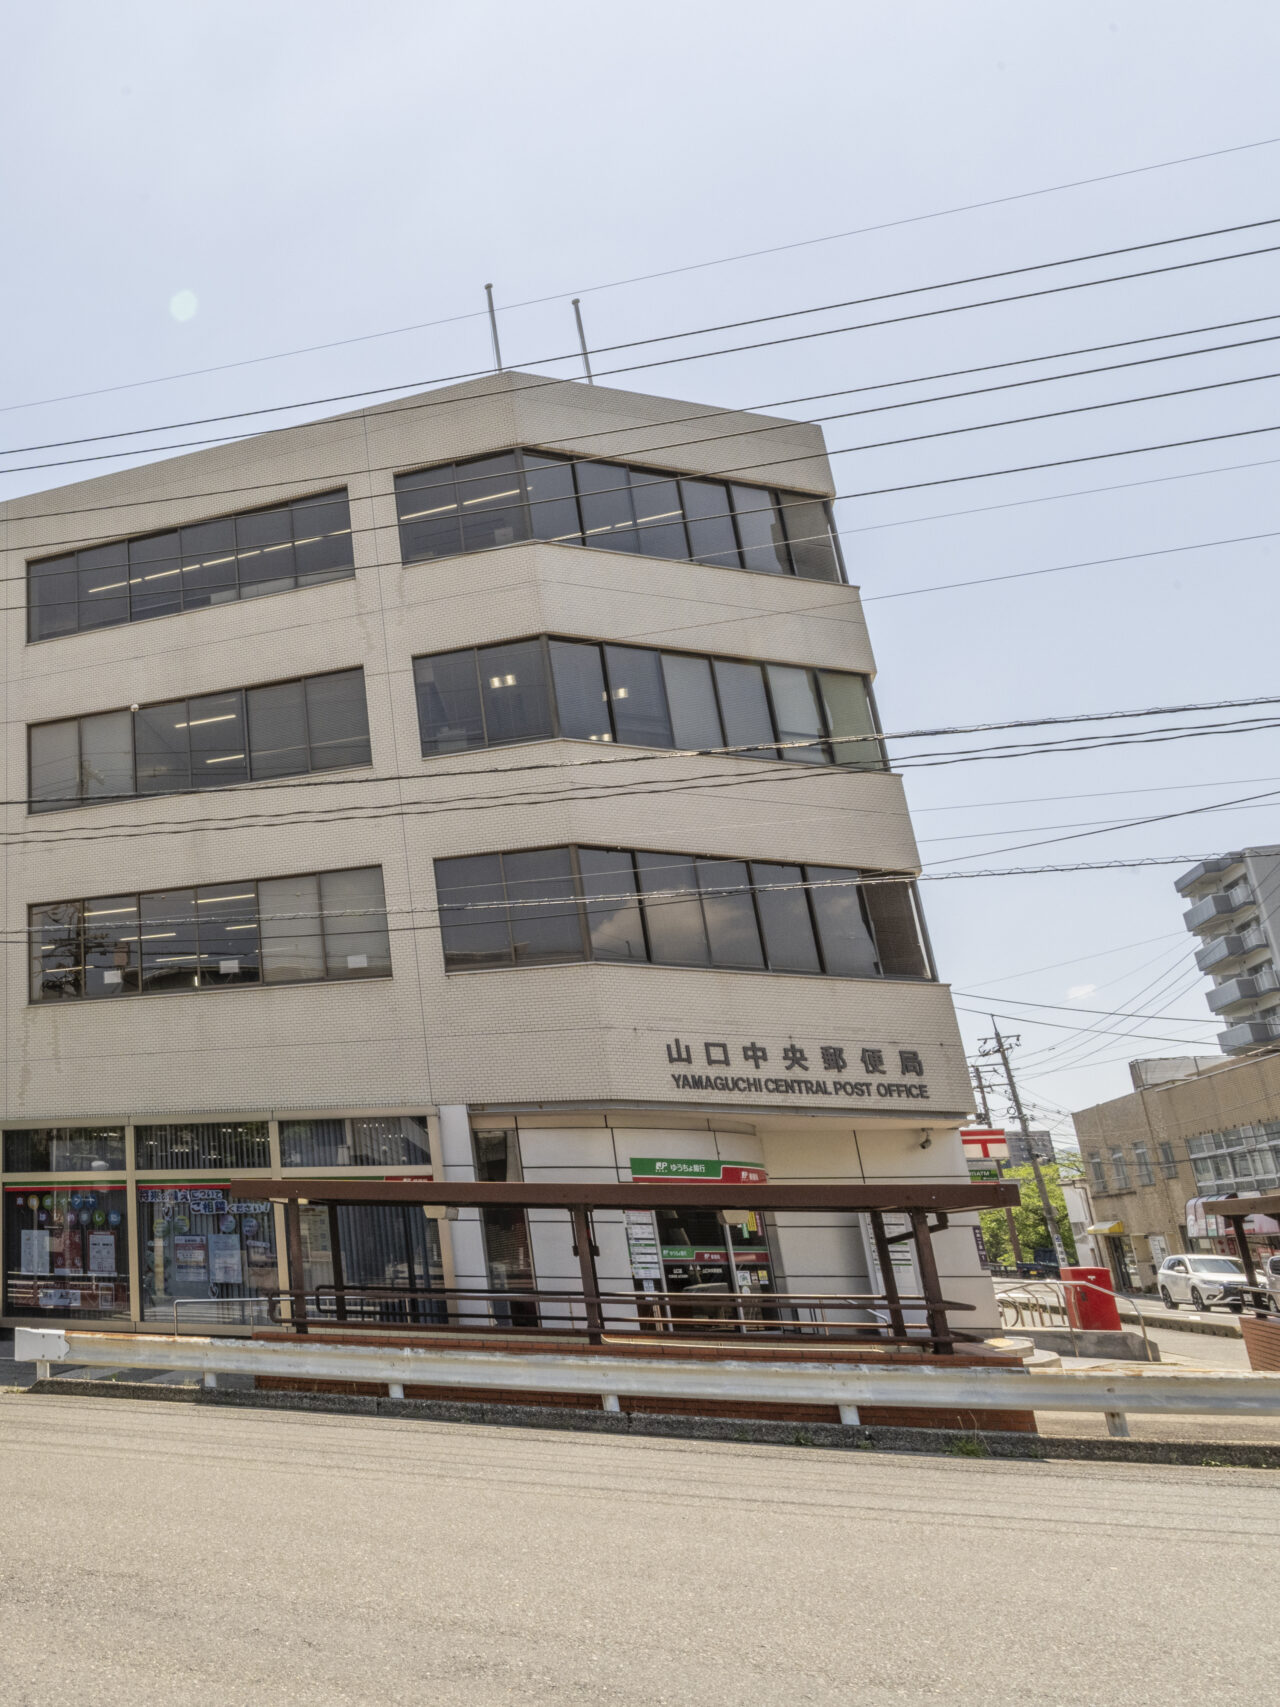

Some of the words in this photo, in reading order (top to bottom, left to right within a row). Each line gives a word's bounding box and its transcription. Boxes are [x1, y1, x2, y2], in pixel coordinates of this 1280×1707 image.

[666, 1038, 924, 1077] 山口中央郵便局
[671, 1074, 763, 1092] YAMAGUCHI
[765, 1078, 833, 1095] CENTRAL
[834, 1081, 873, 1096] POST
[876, 1083, 930, 1099] OFFICE
[670, 1164, 705, 1173] ゆうちょ銀行
